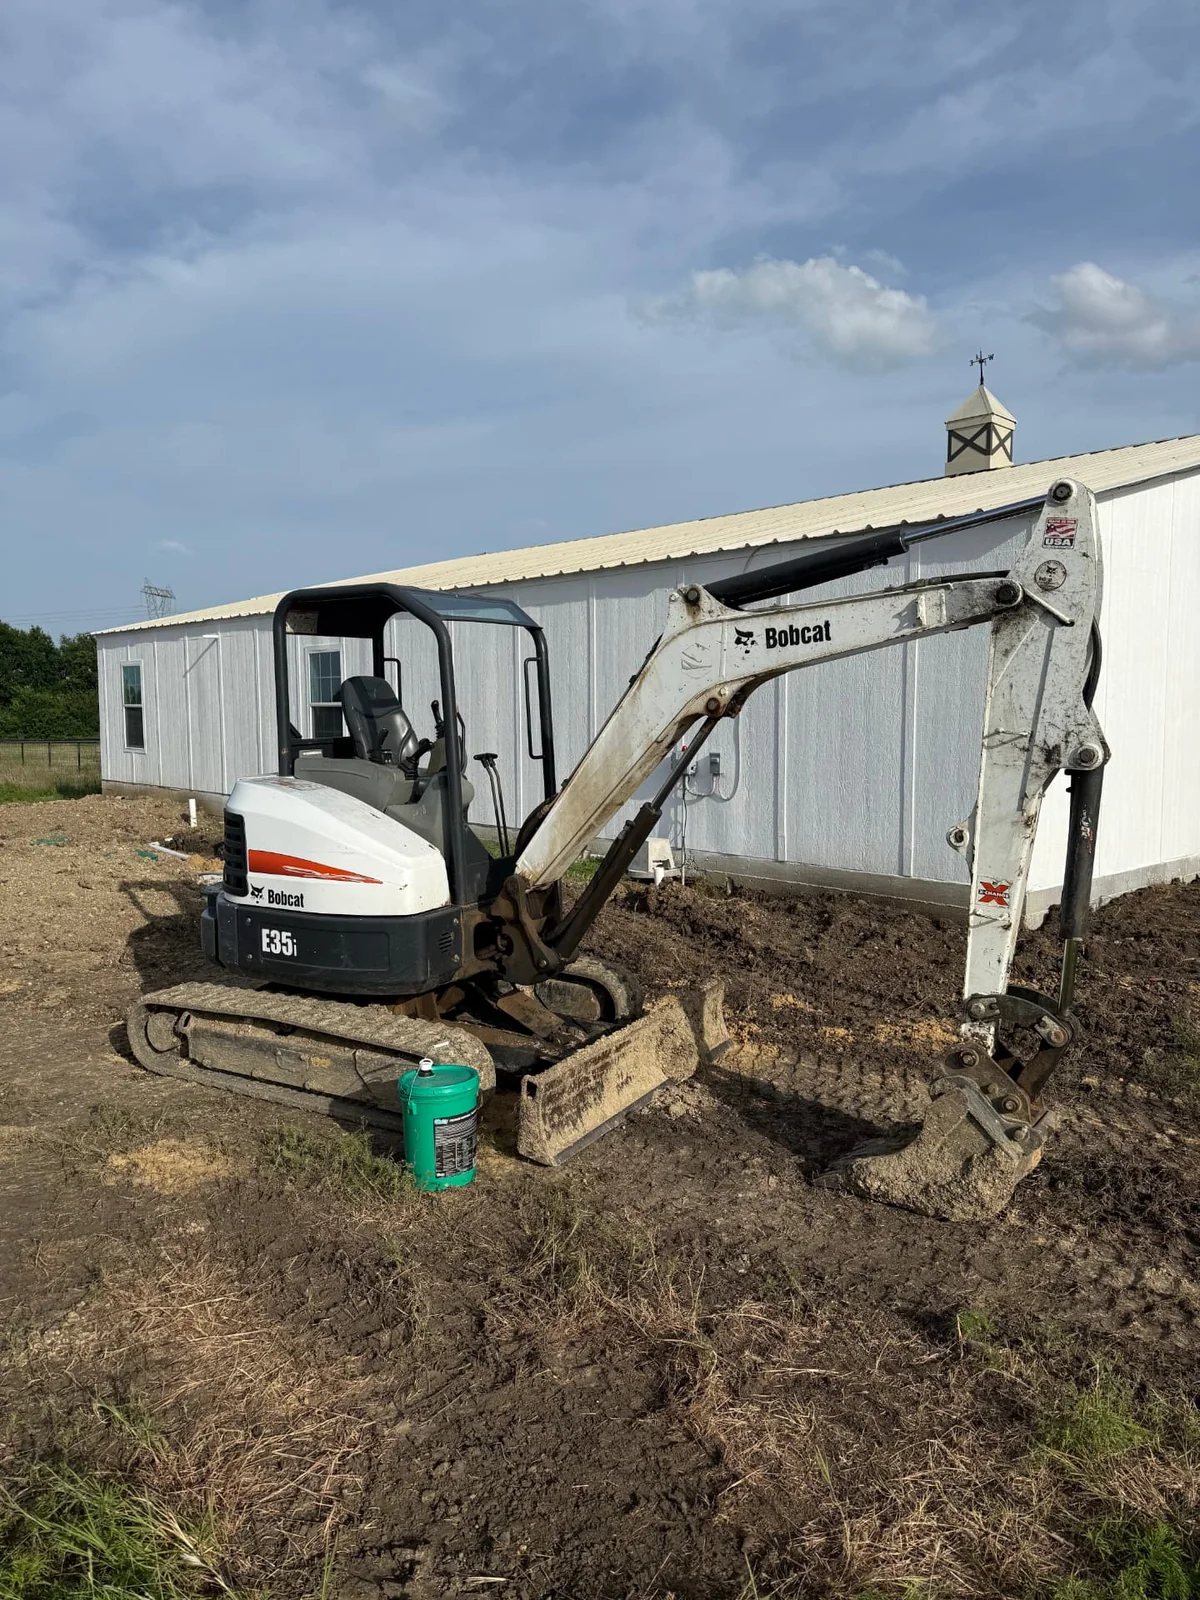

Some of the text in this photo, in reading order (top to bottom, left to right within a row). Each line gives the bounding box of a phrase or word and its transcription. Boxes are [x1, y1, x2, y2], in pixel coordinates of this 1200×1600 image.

[1045, 538, 1071, 546] USA
[765, 620, 831, 649] Bobcat
[267, 889, 304, 908] Bobcat
[261, 928, 297, 957] E35i
